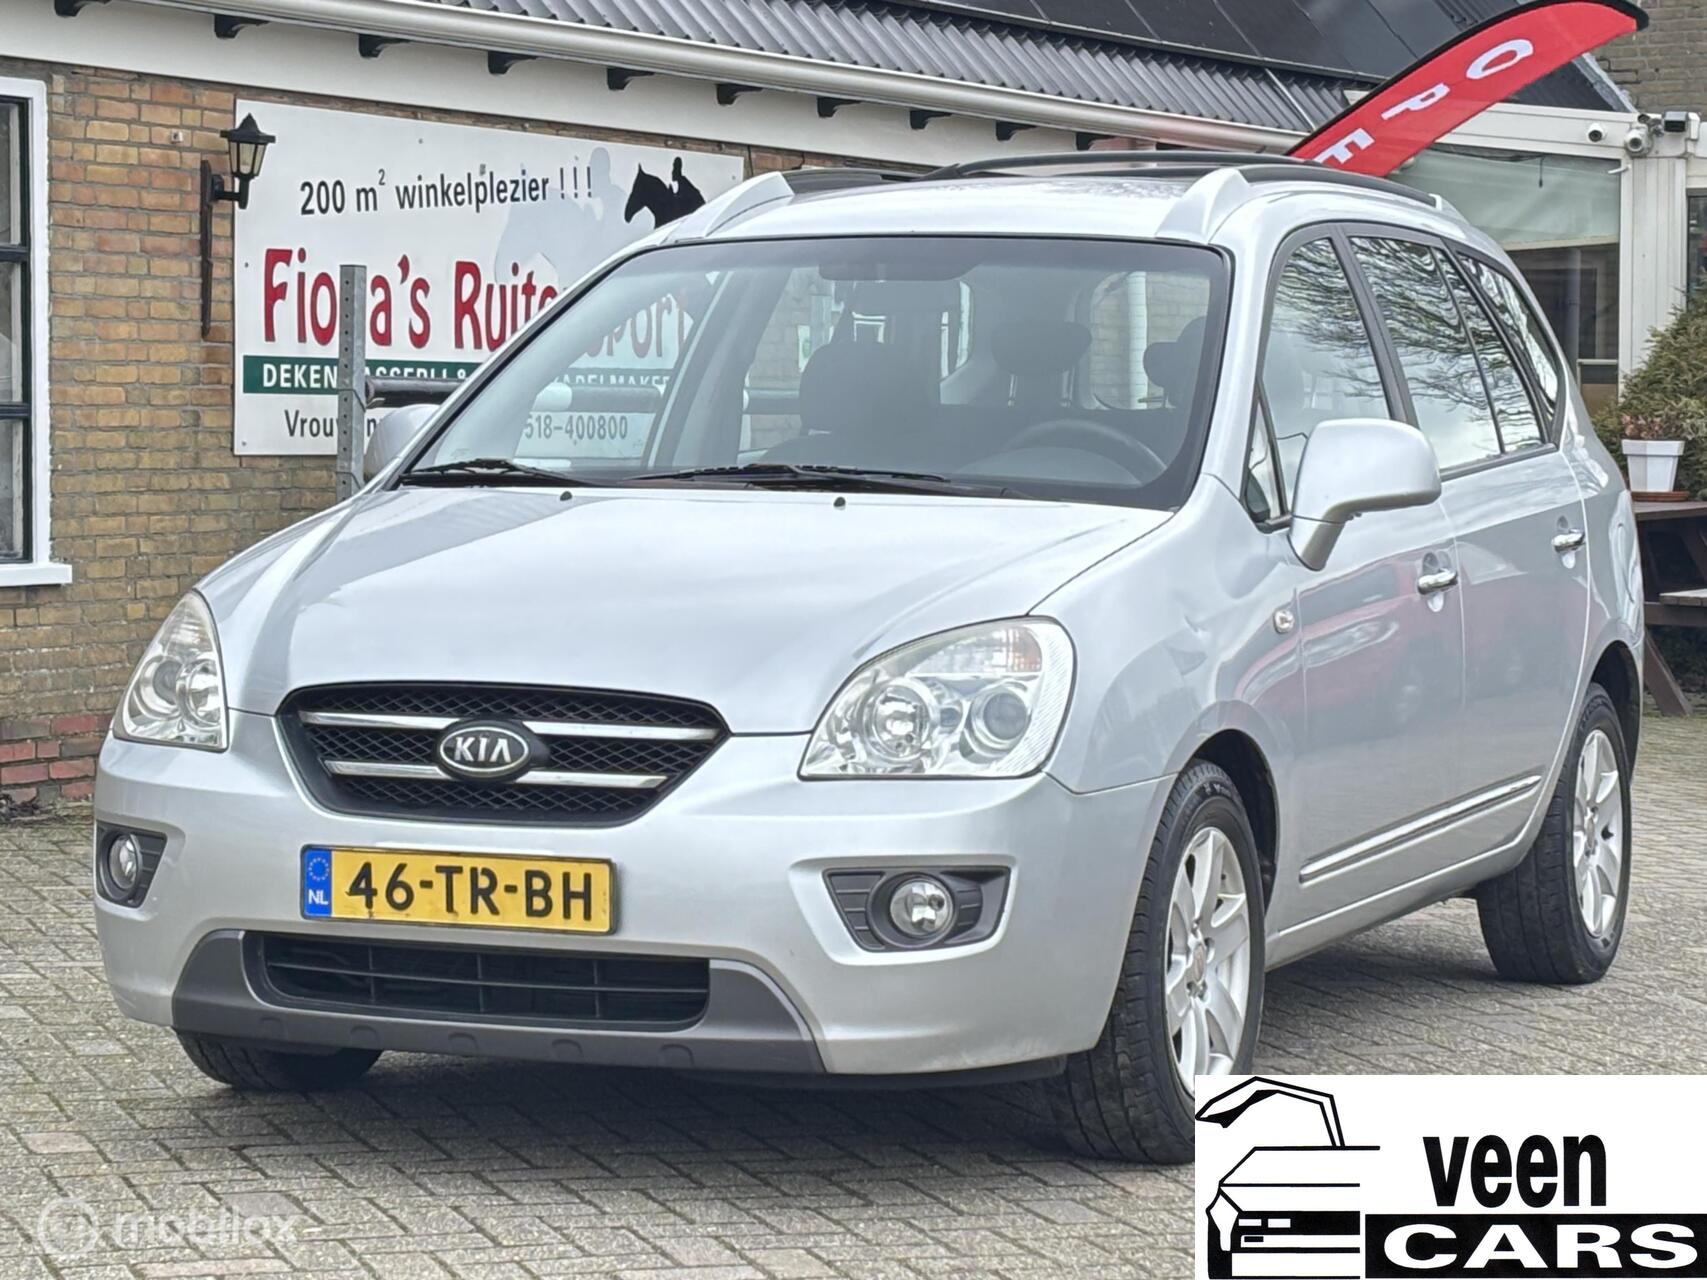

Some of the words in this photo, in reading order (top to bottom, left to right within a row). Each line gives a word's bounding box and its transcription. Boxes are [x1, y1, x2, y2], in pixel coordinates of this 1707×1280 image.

[299, 179, 346, 216] 200
[394, 168, 550, 214] winkelplezier
[263, 246, 432, 350] Fioa's
[452, 736, 513, 764] KIA
[307, 888, 329, 906] NL
[345, 861, 593, 921] 46-TR-BH
